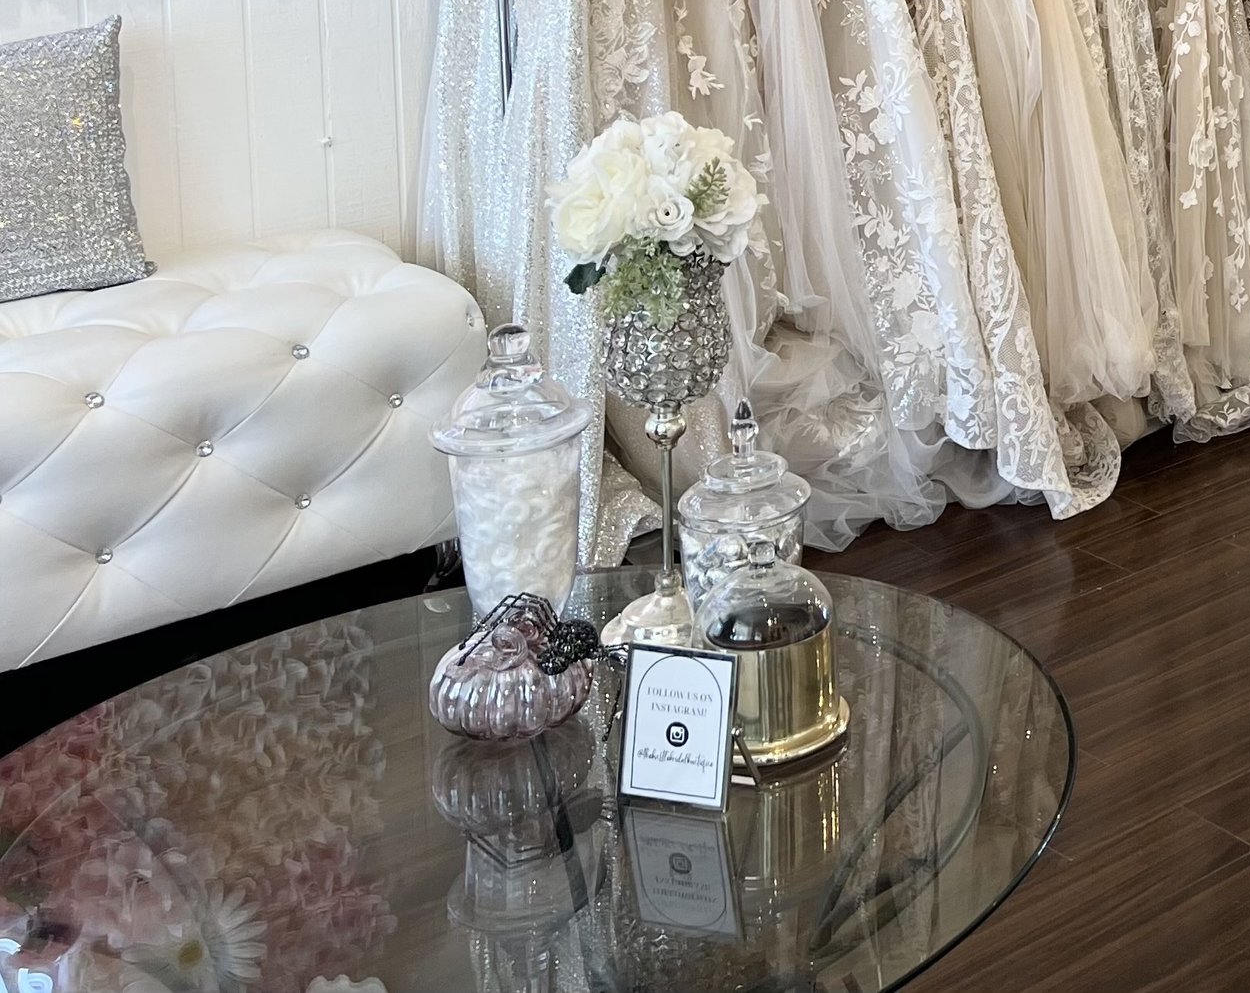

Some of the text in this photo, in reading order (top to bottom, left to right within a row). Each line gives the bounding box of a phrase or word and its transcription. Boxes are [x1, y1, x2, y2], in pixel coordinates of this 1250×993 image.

[647, 687, 713, 702] FOLLOW US ON
